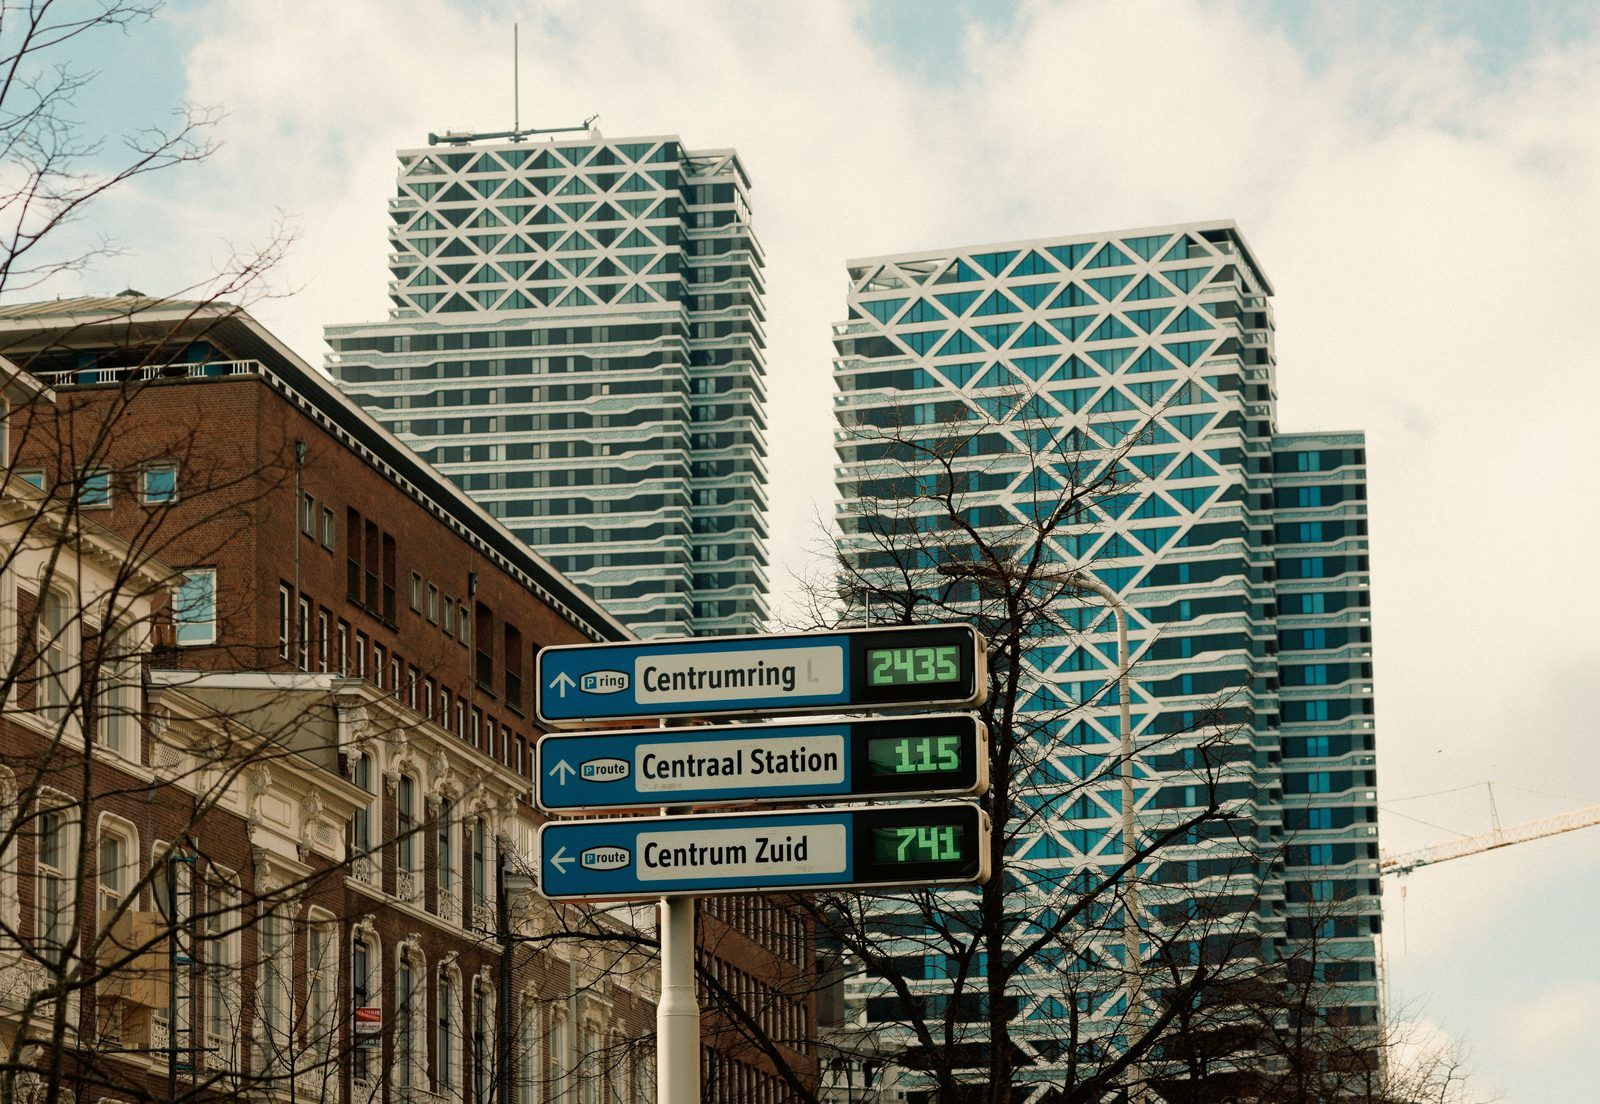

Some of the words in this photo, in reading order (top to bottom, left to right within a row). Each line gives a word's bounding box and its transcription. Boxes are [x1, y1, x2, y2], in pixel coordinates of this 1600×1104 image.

[643, 661, 796, 692] Centrumring
[872, 646, 957, 684] 2435
[599, 674, 625, 689] ring
[596, 763, 625, 775] route
[642, 750, 742, 780] Centraal
[750, 747, 838, 774] Station
[895, 736, 959, 773] 115
[596, 851, 626, 863] route
[644, 842, 748, 868] Centrum
[755, 836, 808, 863] Zuid
[896, 826, 961, 862] 741
